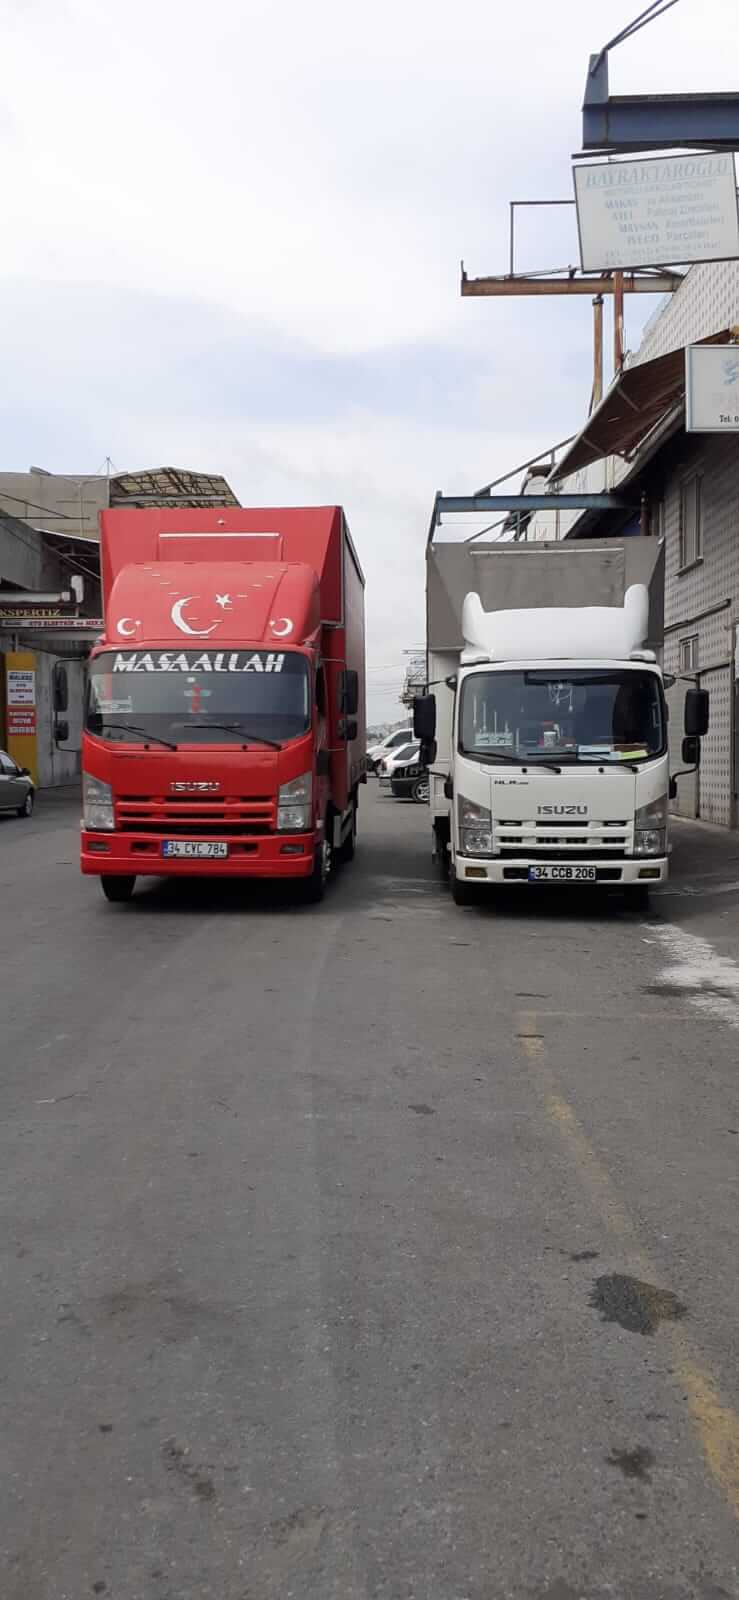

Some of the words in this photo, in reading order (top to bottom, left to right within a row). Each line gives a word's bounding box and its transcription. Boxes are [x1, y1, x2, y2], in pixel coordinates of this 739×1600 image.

[169, 781, 220, 792] ISUZU
[537, 805, 588, 815] ISUZU
[168, 842, 180, 854] 34
[207, 842, 225, 855] 784
[535, 867, 548, 878] 34
[551, 867, 573, 878] CCB
[575, 867, 594, 879] 206
